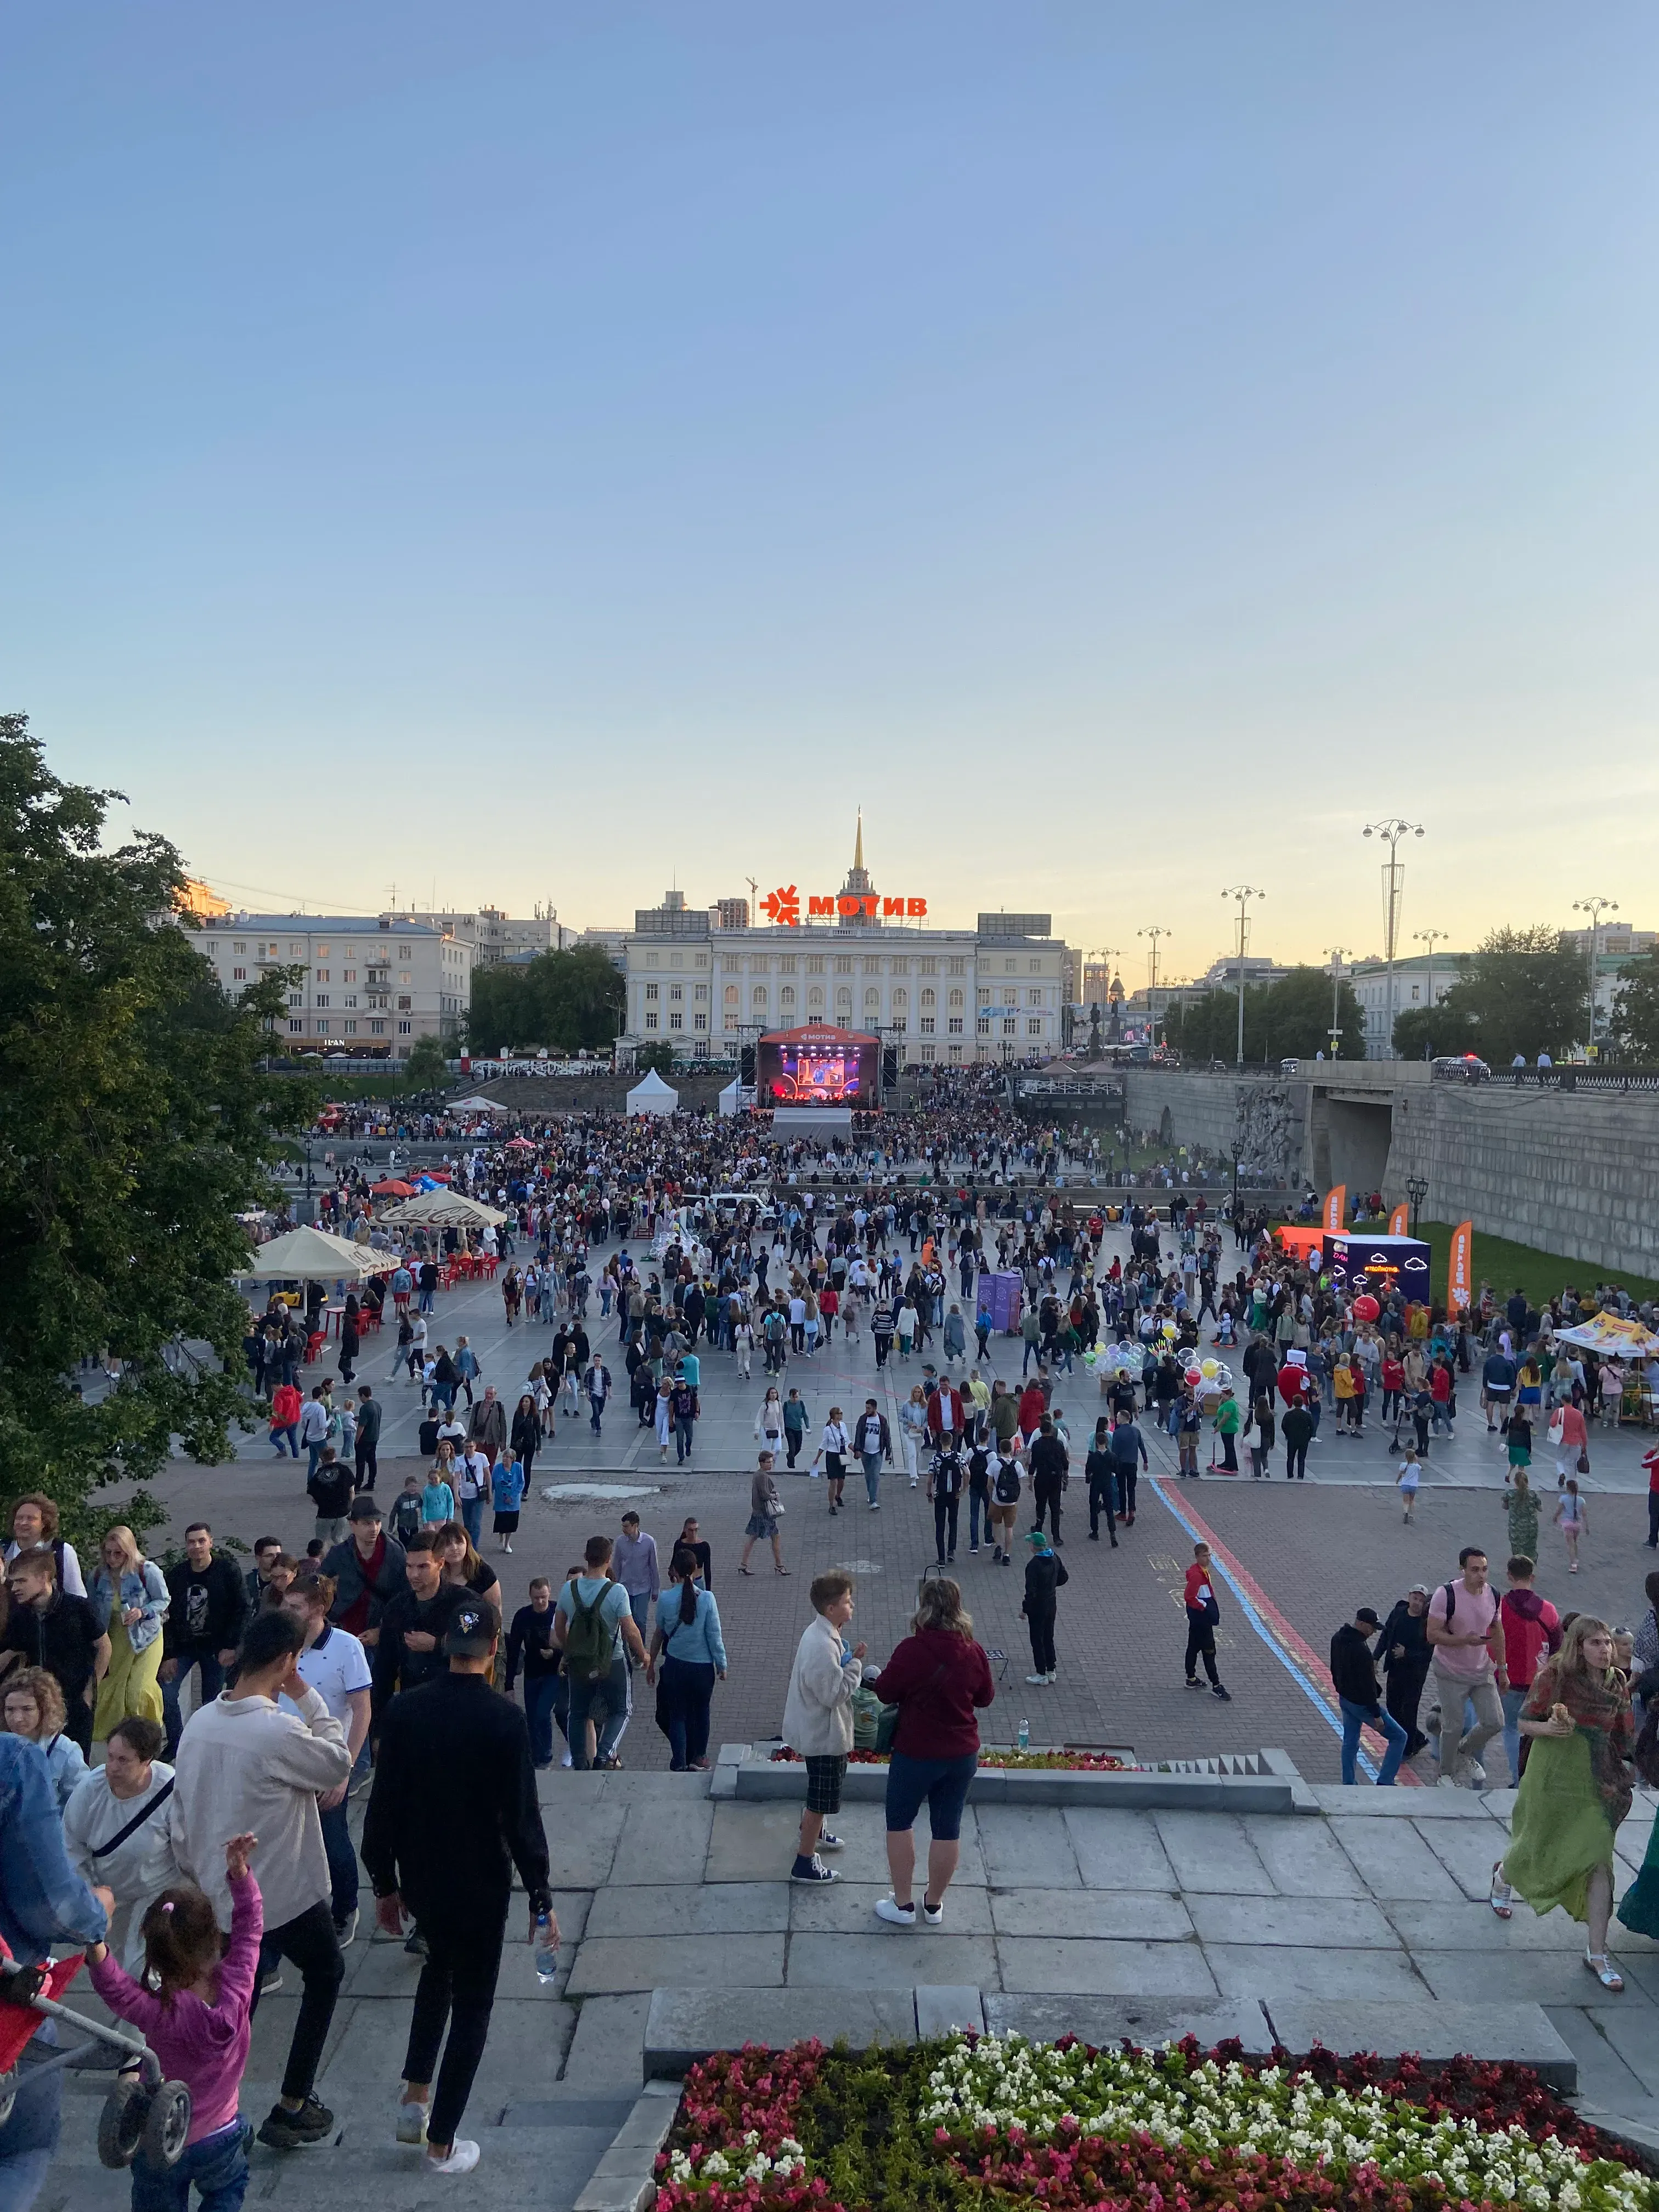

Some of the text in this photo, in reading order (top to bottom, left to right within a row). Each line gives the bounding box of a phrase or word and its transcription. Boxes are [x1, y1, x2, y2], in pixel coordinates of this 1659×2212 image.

[809, 896, 927, 916] МОТИВ
[375, 1204, 484, 1226] Coca-Cola
[1456, 1234, 1465, 1284] МОТИВ
